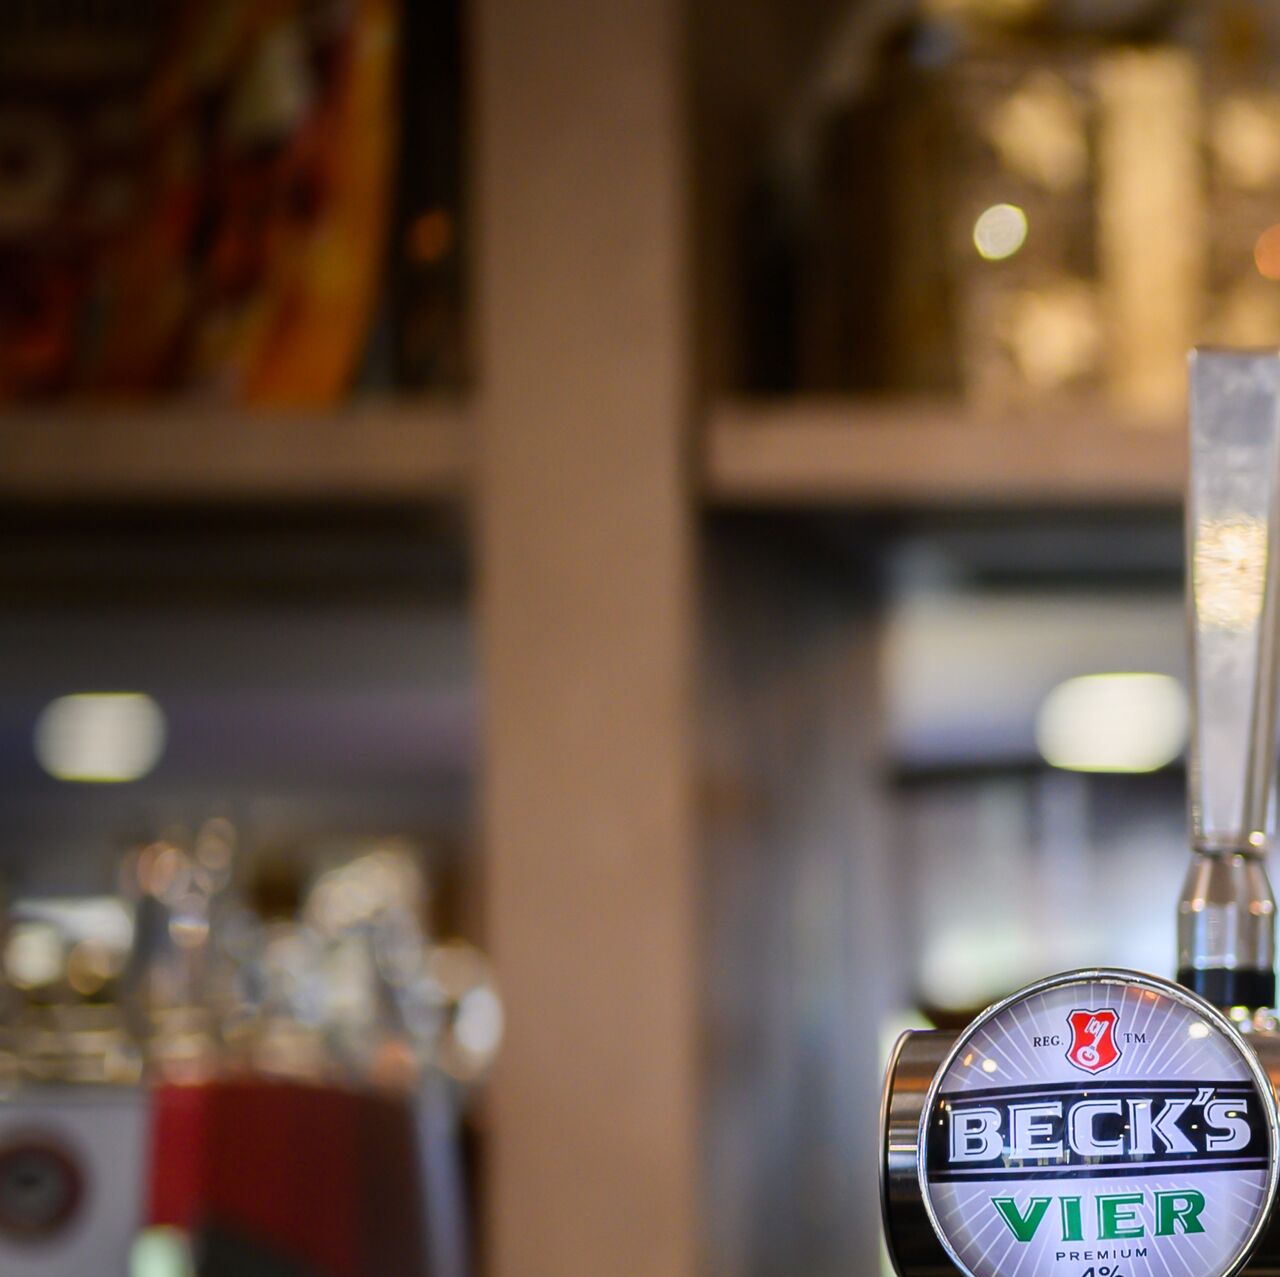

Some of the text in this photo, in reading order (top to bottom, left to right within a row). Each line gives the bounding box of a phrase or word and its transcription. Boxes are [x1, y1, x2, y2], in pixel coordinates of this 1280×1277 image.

[948, 1087, 1251, 1163] BECK'S
[990, 1189, 1206, 1243] VIER
[1055, 1248, 1149, 1262] PREMIUM
